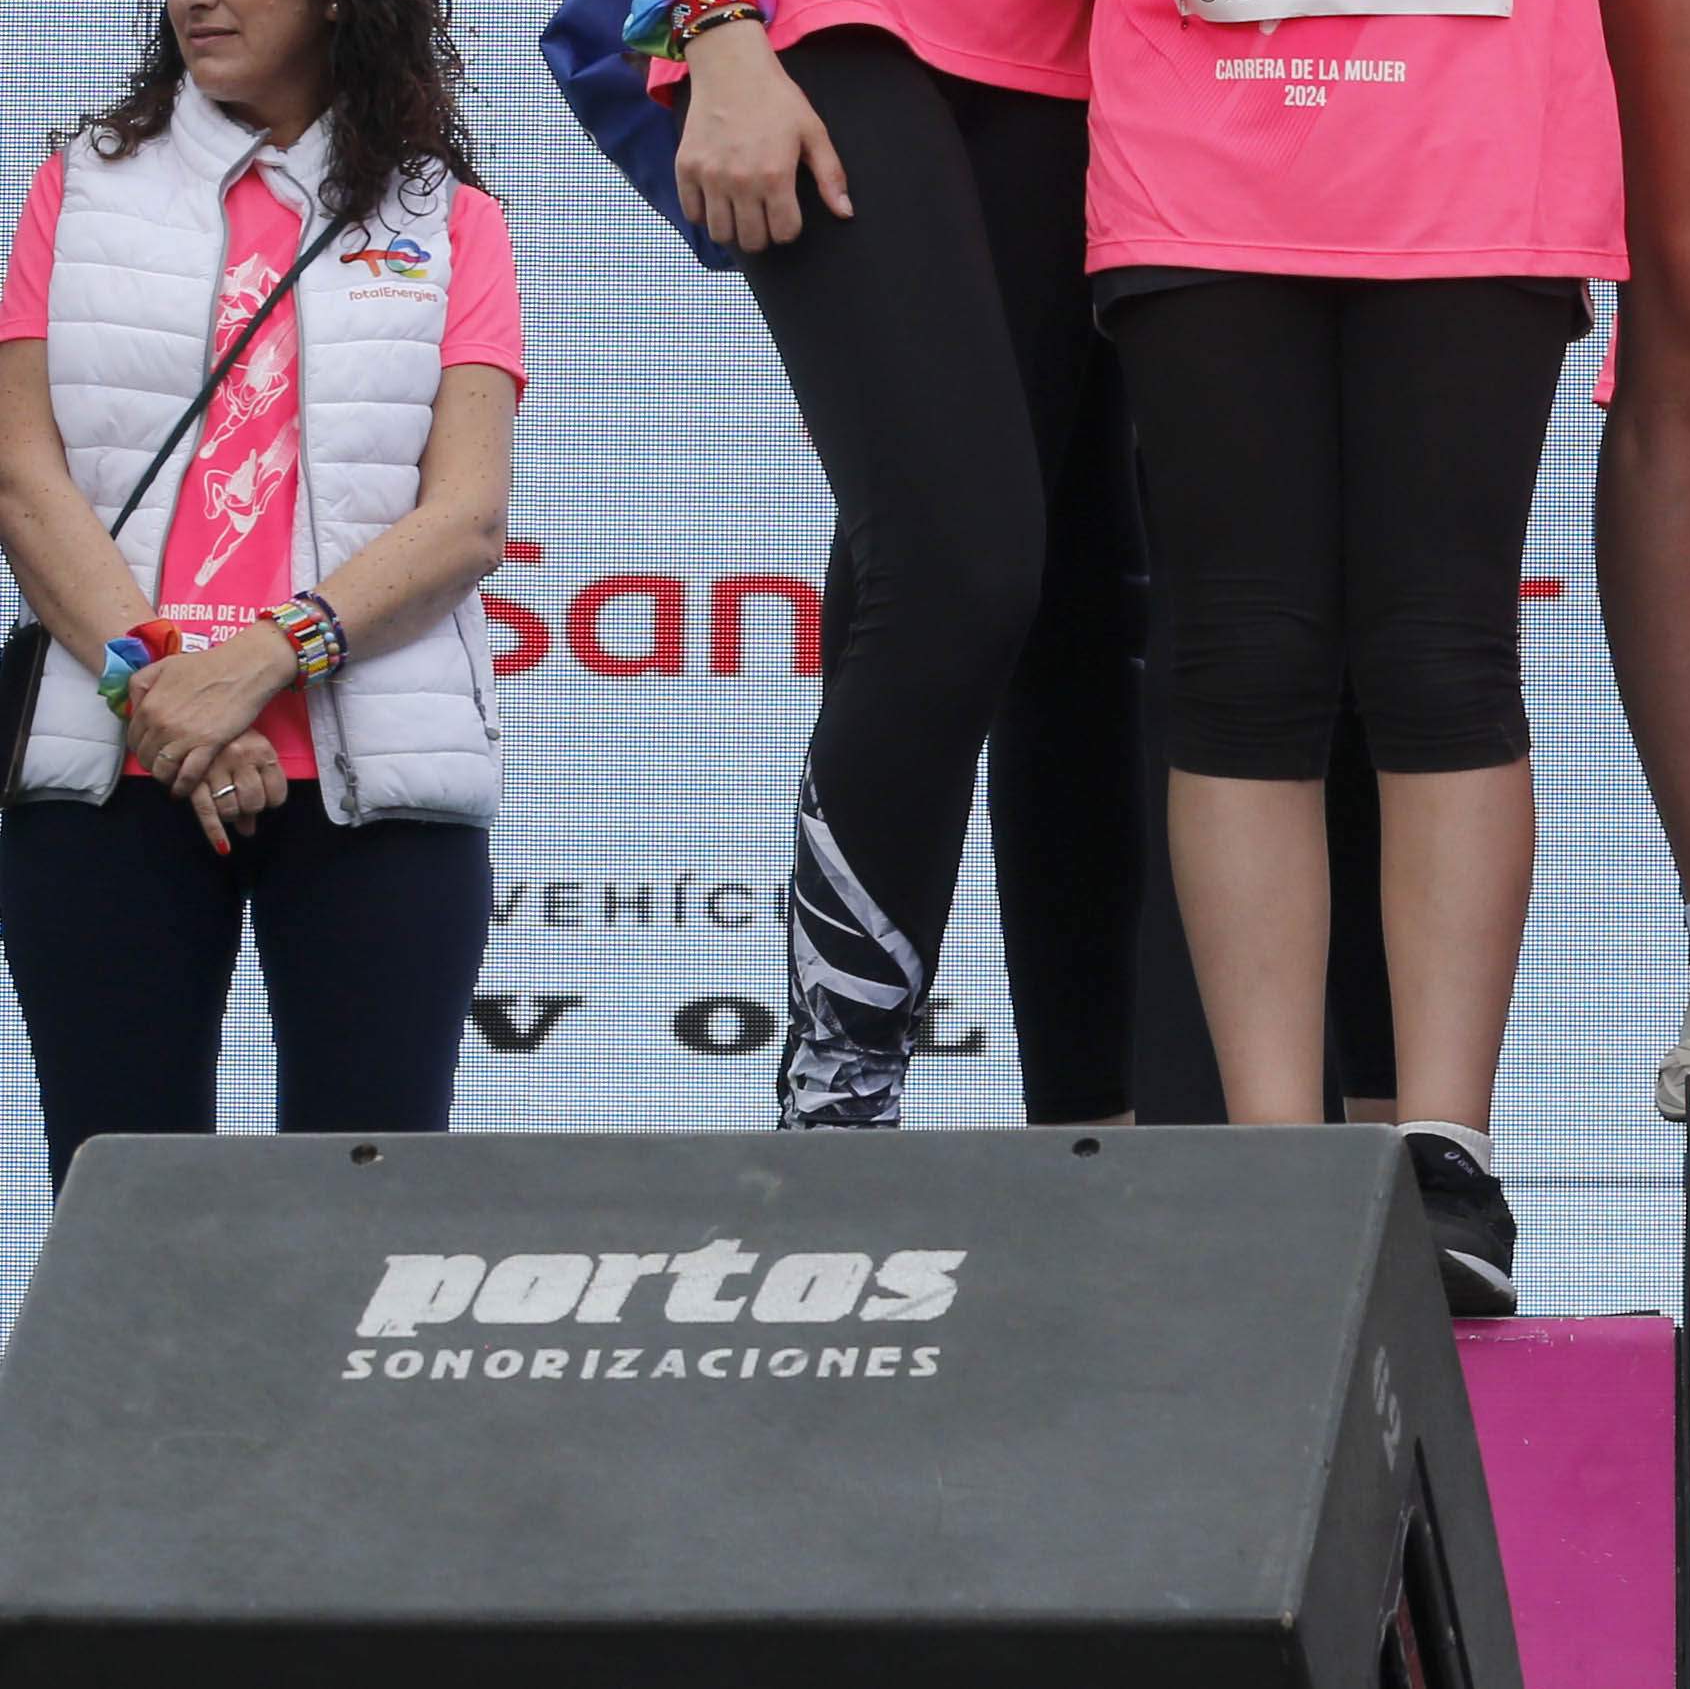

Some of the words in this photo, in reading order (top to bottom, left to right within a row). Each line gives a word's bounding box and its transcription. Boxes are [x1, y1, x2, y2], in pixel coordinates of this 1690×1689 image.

[1215, 59, 1286, 81] CARRERA
[1291, 60, 1313, 81] DE
[1319, 61, 1340, 81] LA
[1345, 61, 1407, 82] MUJER
[1285, 86, 1327, 107] 2024
[349, 287, 438, 303] TotalEnergies
[217, 605, 235, 622] DE
[239, 607, 257, 624] LA
[355, 1238, 968, 1338] portos
[340, 1346, 941, 1382] SONORIZACIONES
